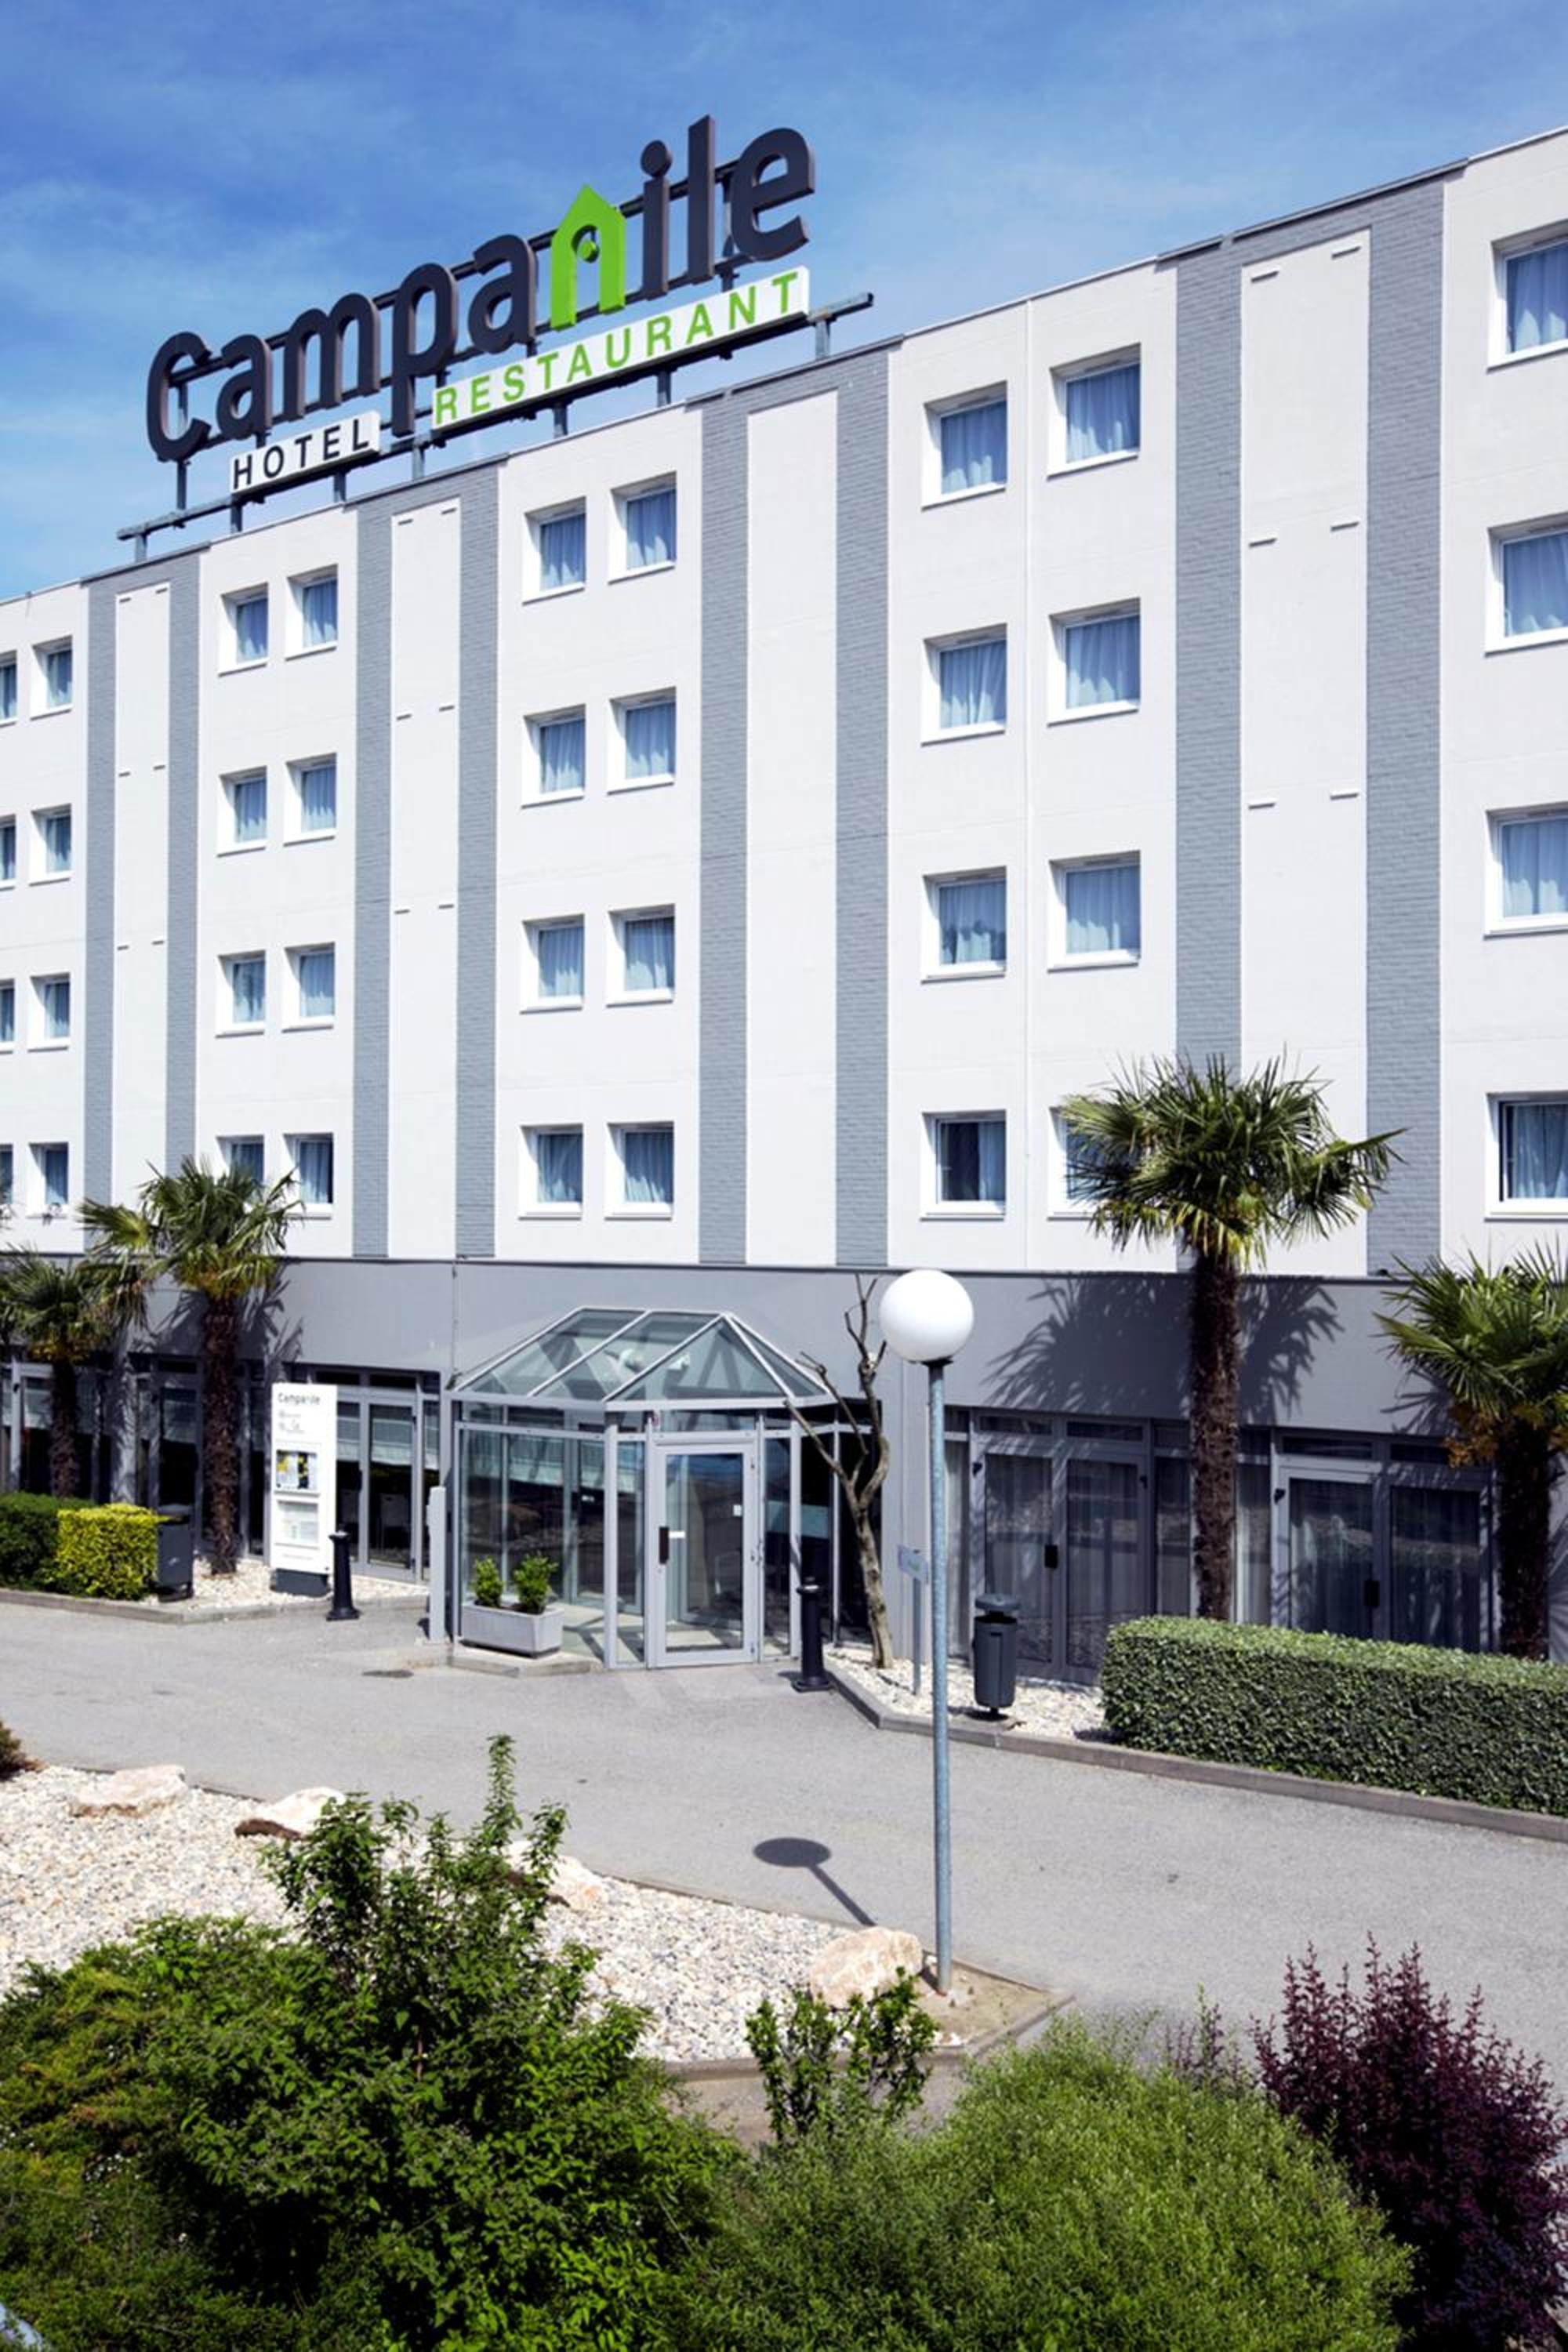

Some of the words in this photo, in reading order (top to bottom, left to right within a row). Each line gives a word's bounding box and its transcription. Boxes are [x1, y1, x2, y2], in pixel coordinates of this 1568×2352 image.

[147, 114, 816, 462] Campanile
[233, 417, 371, 492] HOTEL
[434, 271, 800, 426] RESTAURANT
